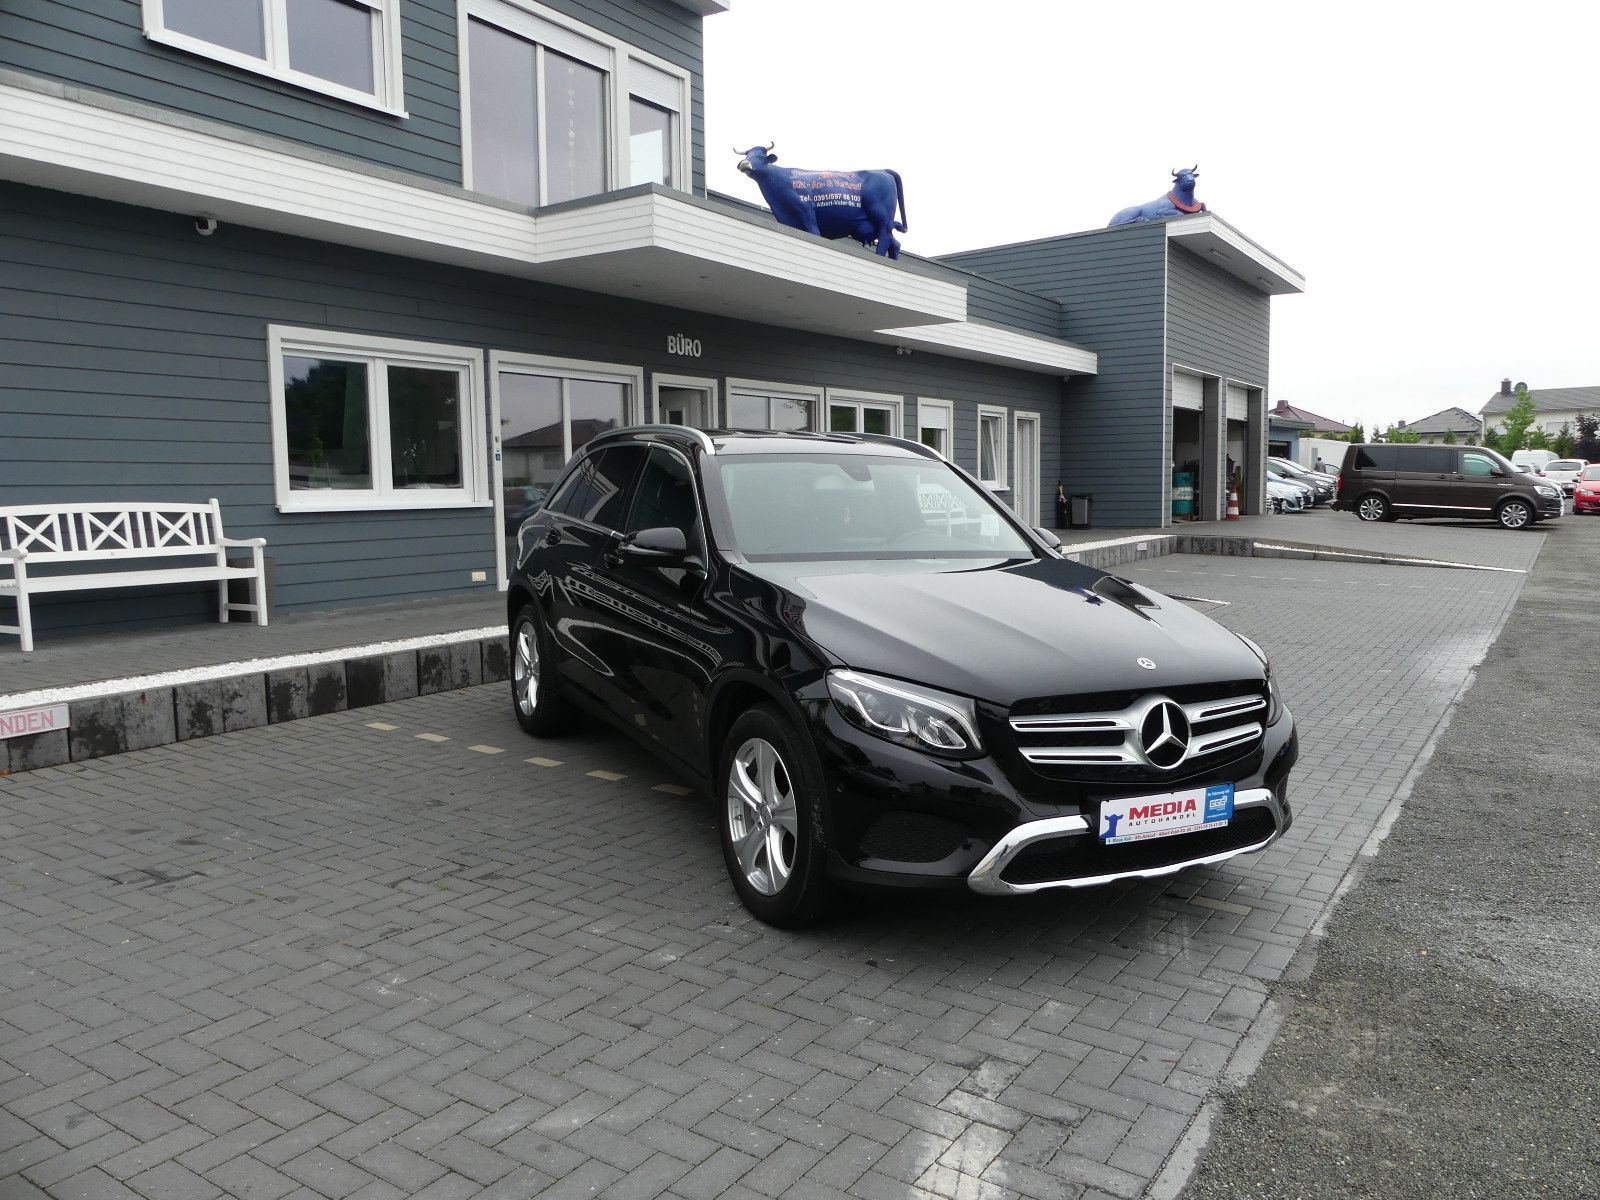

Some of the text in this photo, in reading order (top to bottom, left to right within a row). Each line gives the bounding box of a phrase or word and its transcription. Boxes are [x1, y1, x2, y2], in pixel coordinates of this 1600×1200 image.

[667, 333, 702, 358] BÜRO
[1128, 812, 1197, 827] AUTOHANDEL
[1129, 799, 1197, 820] MEDIA
